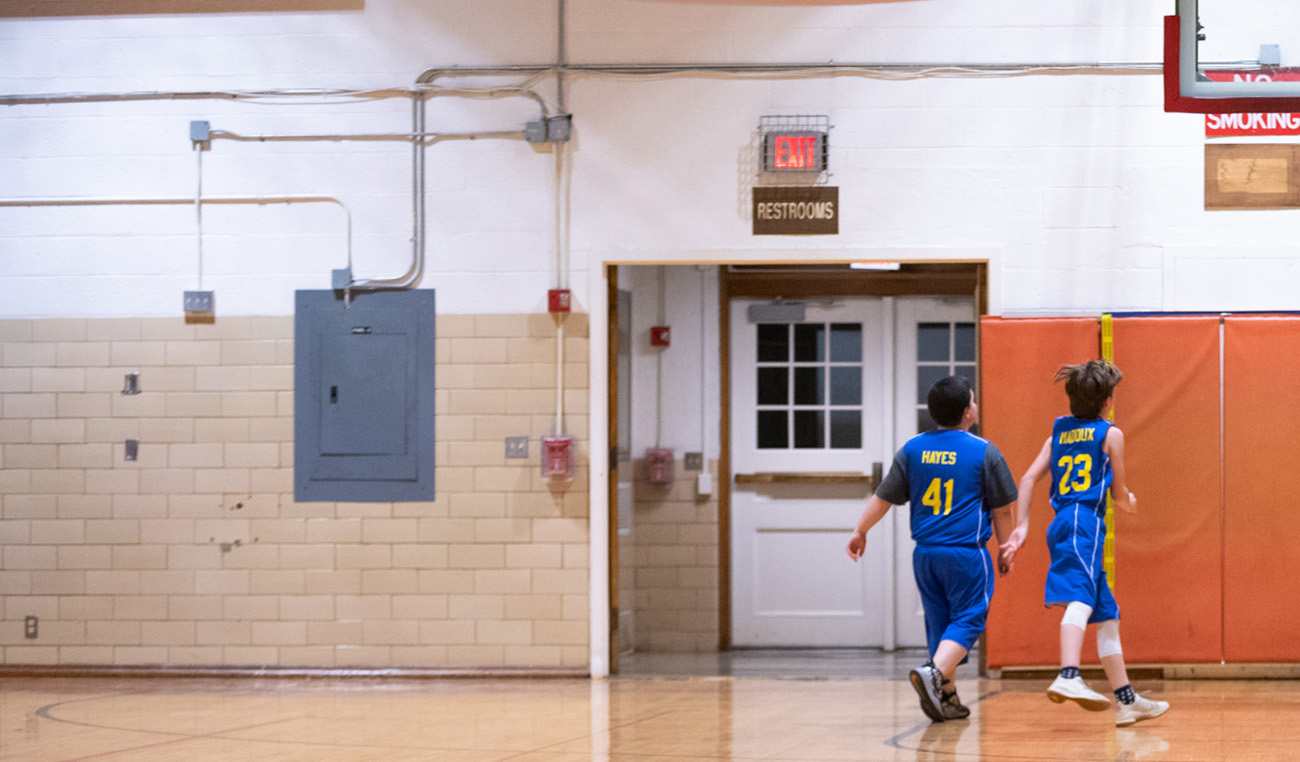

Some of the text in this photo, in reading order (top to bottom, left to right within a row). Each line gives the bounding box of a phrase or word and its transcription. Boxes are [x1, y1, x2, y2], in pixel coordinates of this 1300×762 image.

[1206, 113, 1300, 129] SMOKING
[774, 136, 816, 168] EXIT
[757, 202, 834, 220] RESTROOMS
[921, 450, 957, 466] HAYES
[1058, 453, 1093, 495] 23
[921, 477, 955, 516] 41
